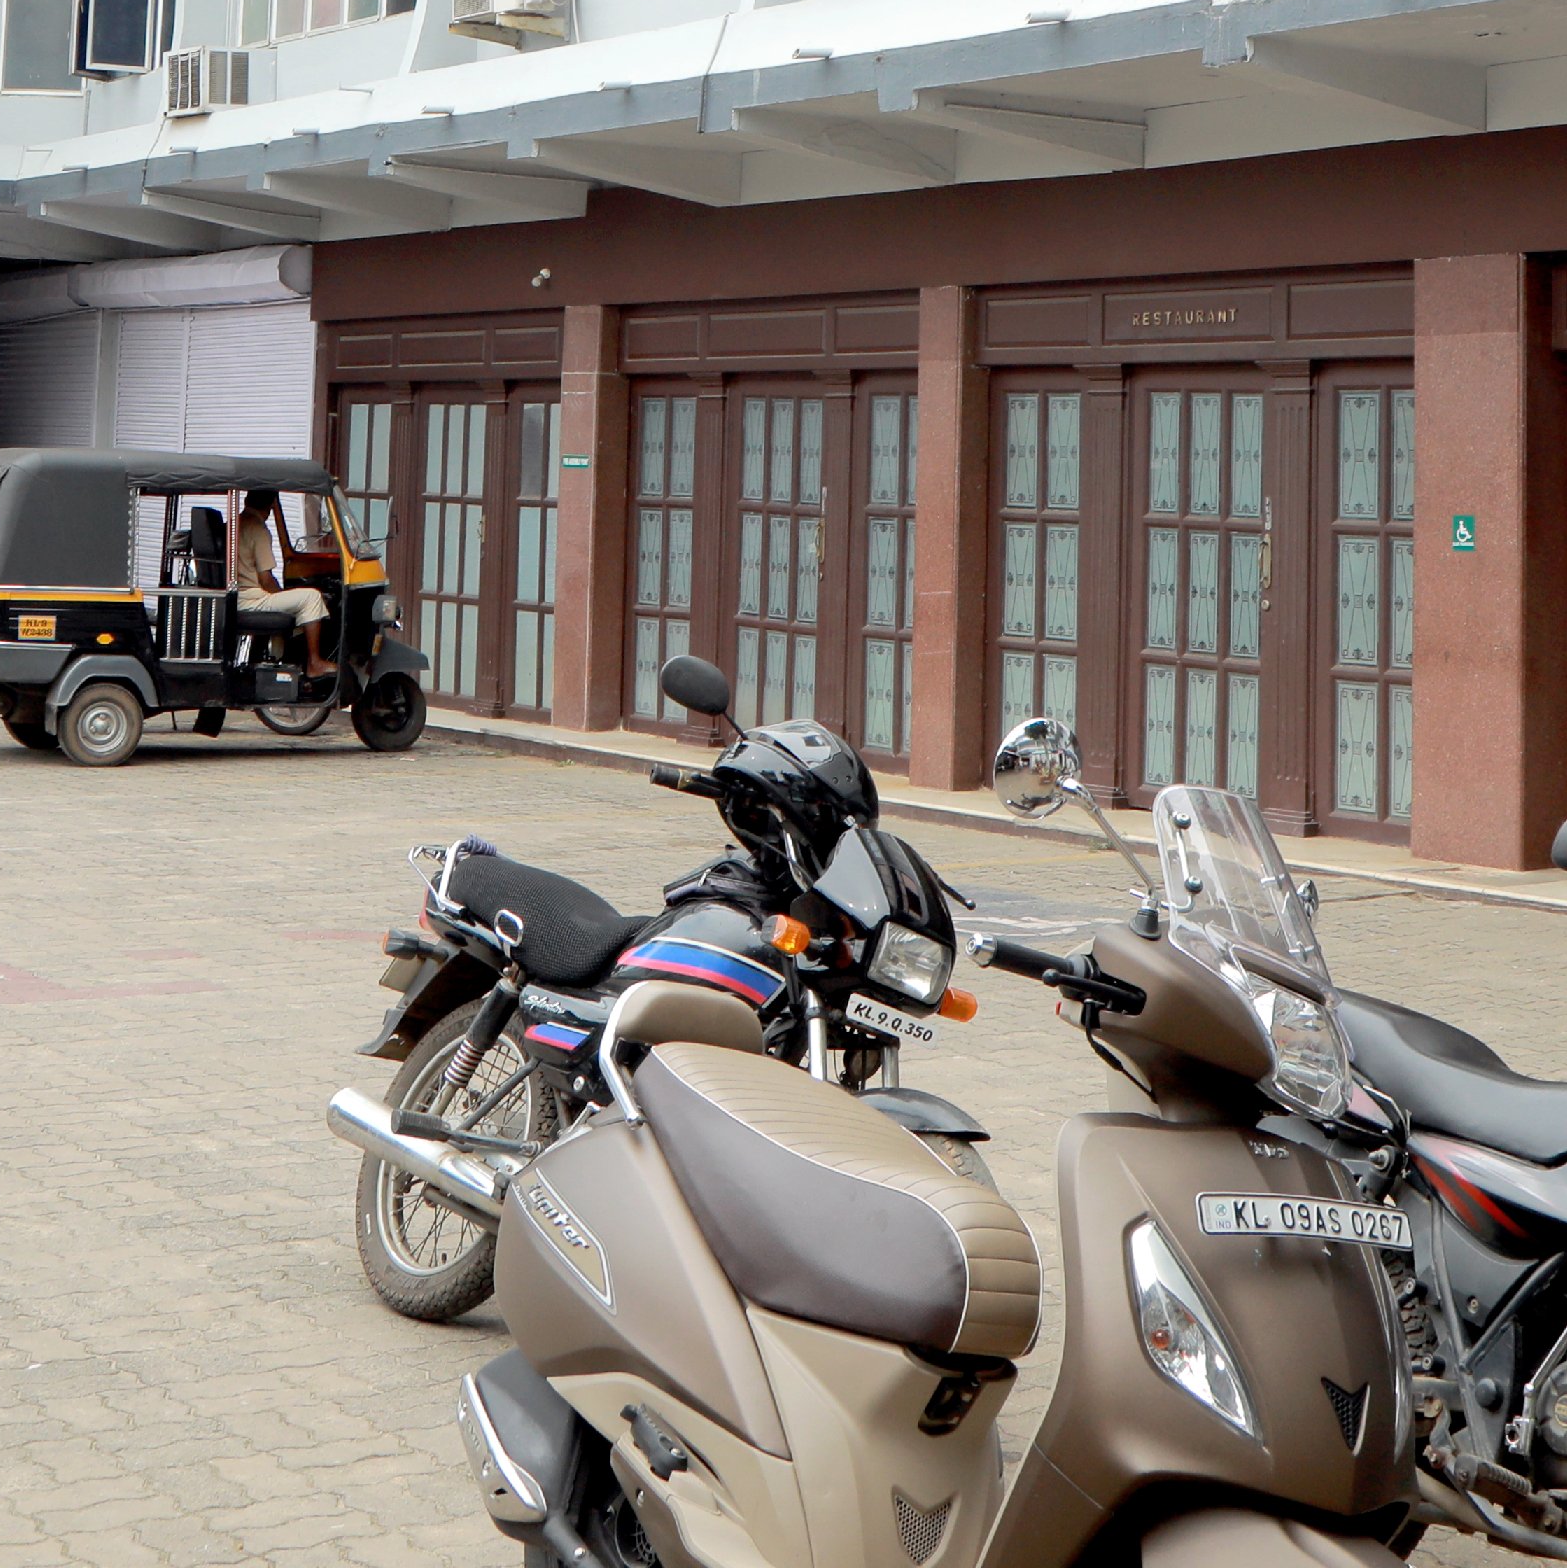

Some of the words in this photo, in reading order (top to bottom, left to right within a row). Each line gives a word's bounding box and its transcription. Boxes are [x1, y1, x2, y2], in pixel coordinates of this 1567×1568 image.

[1132, 308, 1237, 326] RESTAURANT
[1215, 1220, 1232, 1229] IND
[1350, 1210, 1403, 1243] 0267
